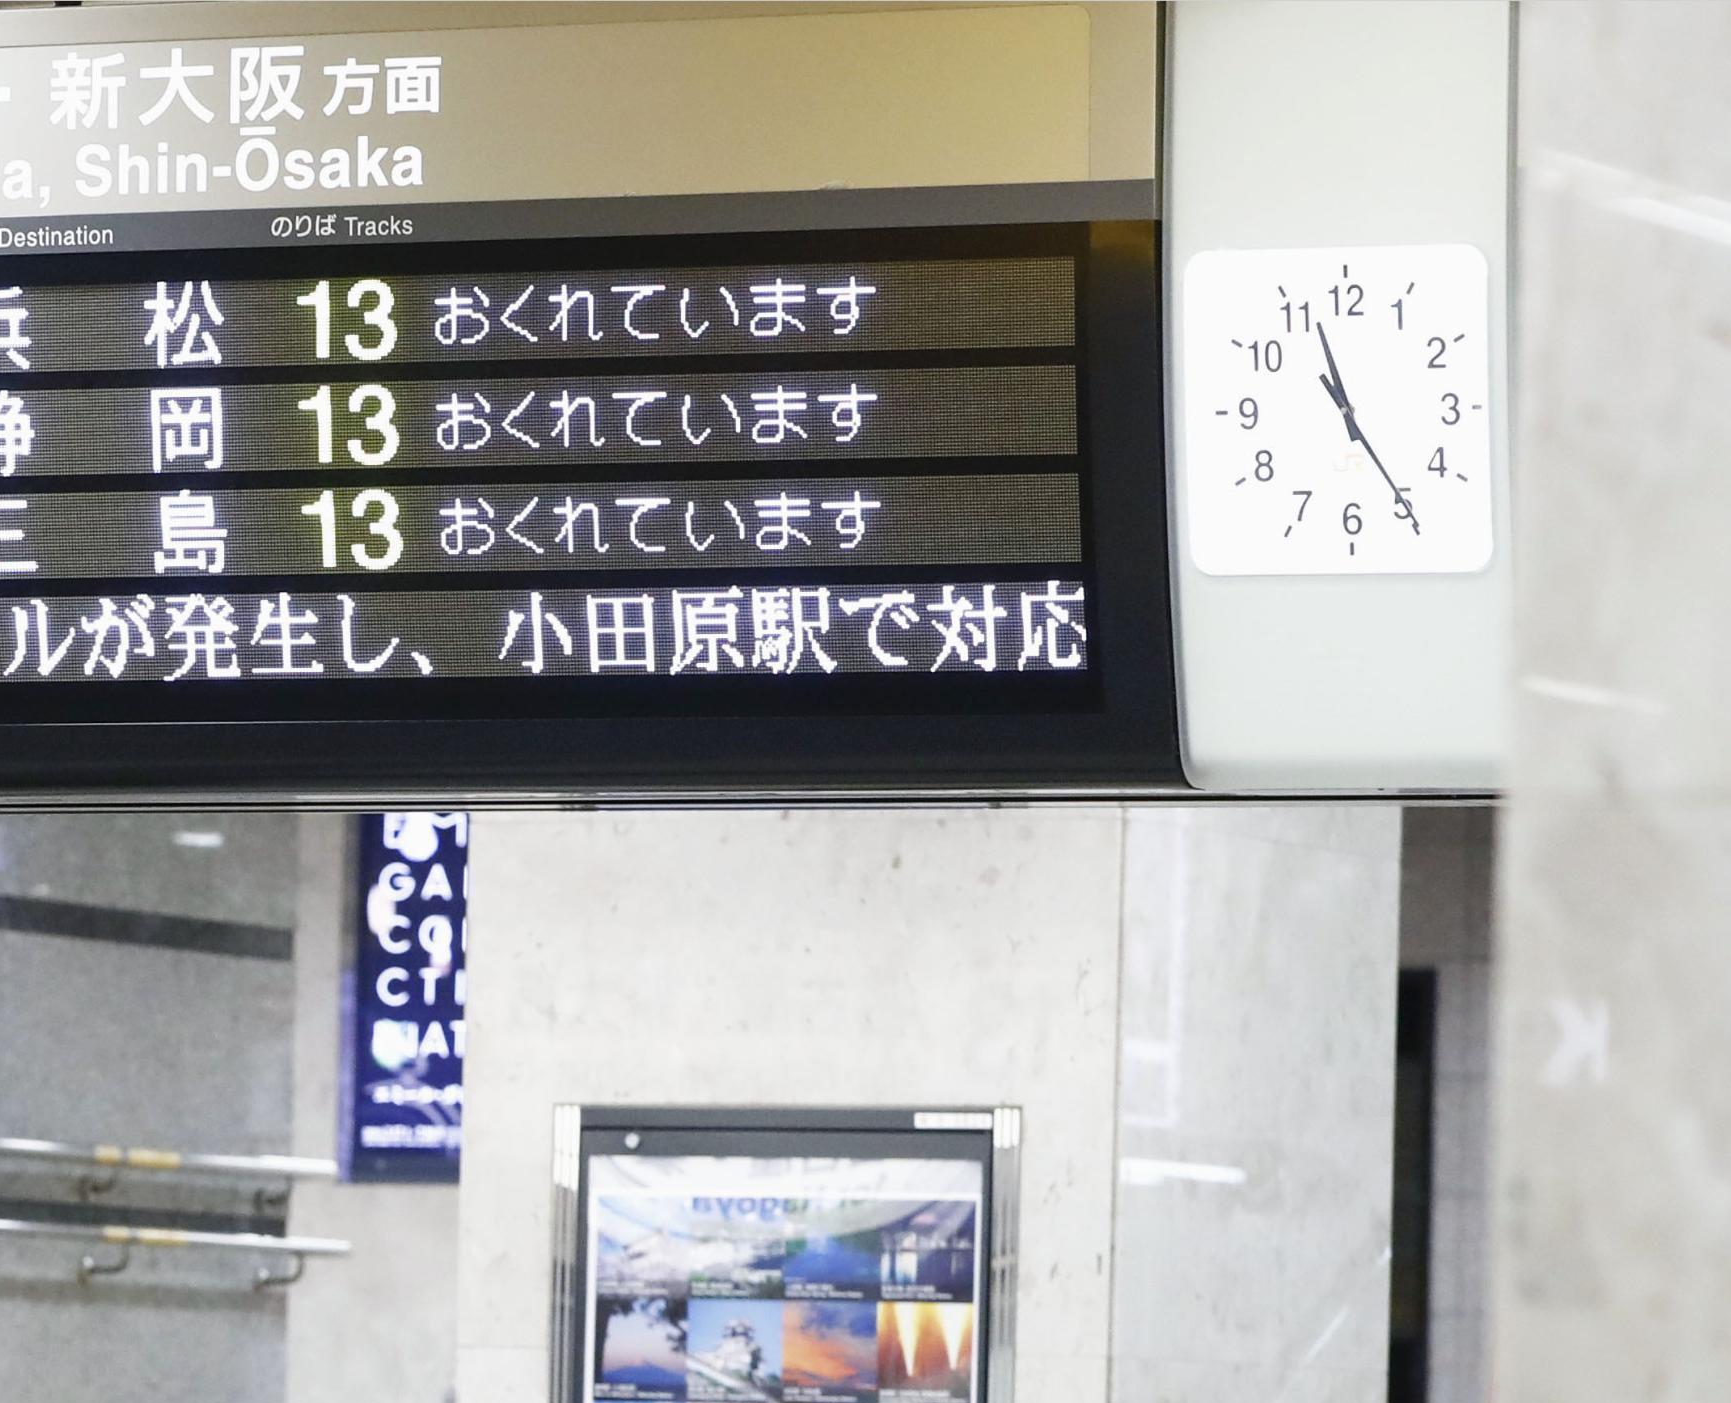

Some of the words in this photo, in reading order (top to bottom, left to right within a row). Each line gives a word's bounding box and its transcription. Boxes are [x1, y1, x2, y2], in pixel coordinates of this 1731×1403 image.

[74, 127, 424, 197] Shin-Ōsaka
[271, 214, 336, 238] のりば
[344, 215, 413, 237] Tracks
[1328, 284, 1364, 316] 12
[1390, 299, 1403, 330] 1
[296, 279, 398, 361] 13
[434, 276, 876, 345] おくれています
[1280, 301, 1310, 333] 11
[1248, 340, 1282, 373] 10
[1427, 337, 1447, 369] 2
[297, 383, 400, 466] 13
[435, 383, 878, 450] おくれています
[1238, 397, 1259, 430] 9
[1441, 393, 1461, 426] 3
[1254, 449, 1275, 482] 8
[1427, 446, 1448, 478] 4
[1292, 490, 1313, 522] 7
[1342, 502, 1363, 535] 6
[1393, 487, 1413, 520] 5
[300, 488, 404, 571] 13
[439, 490, 881, 555] おくれています
[378, 861, 467, 902] GA
